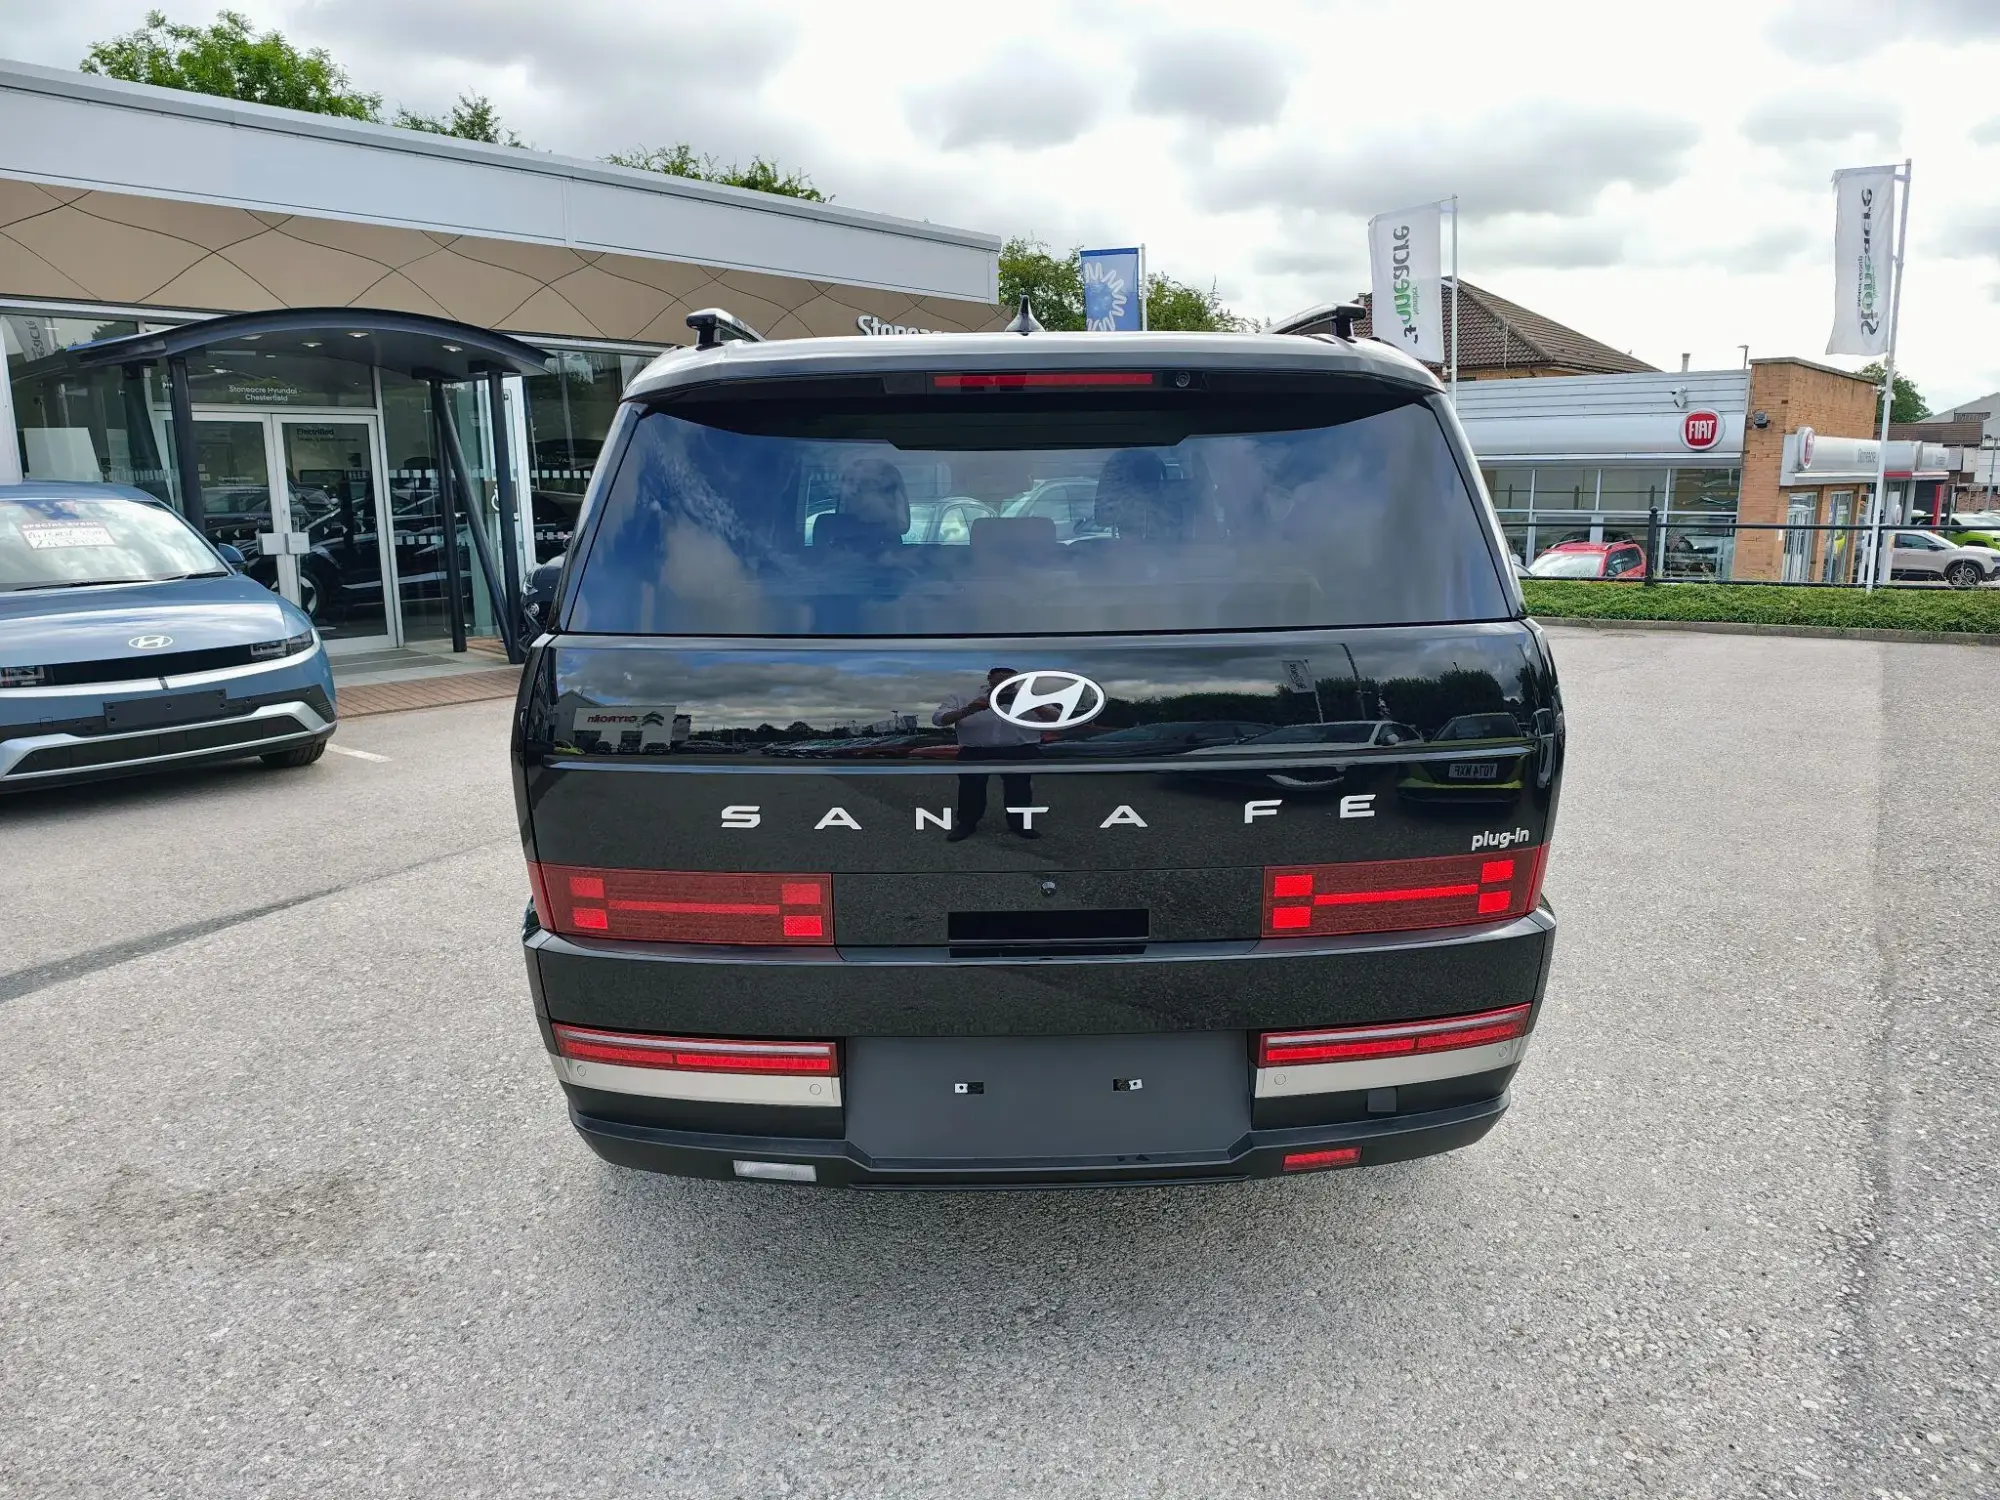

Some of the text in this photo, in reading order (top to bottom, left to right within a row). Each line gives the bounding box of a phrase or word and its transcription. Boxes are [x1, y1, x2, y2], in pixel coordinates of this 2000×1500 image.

[1688, 420, 1715, 440] FIAT
[720, 793, 1377, 831] SANTA FE
[1471, 827, 1530, 851] plug-in
